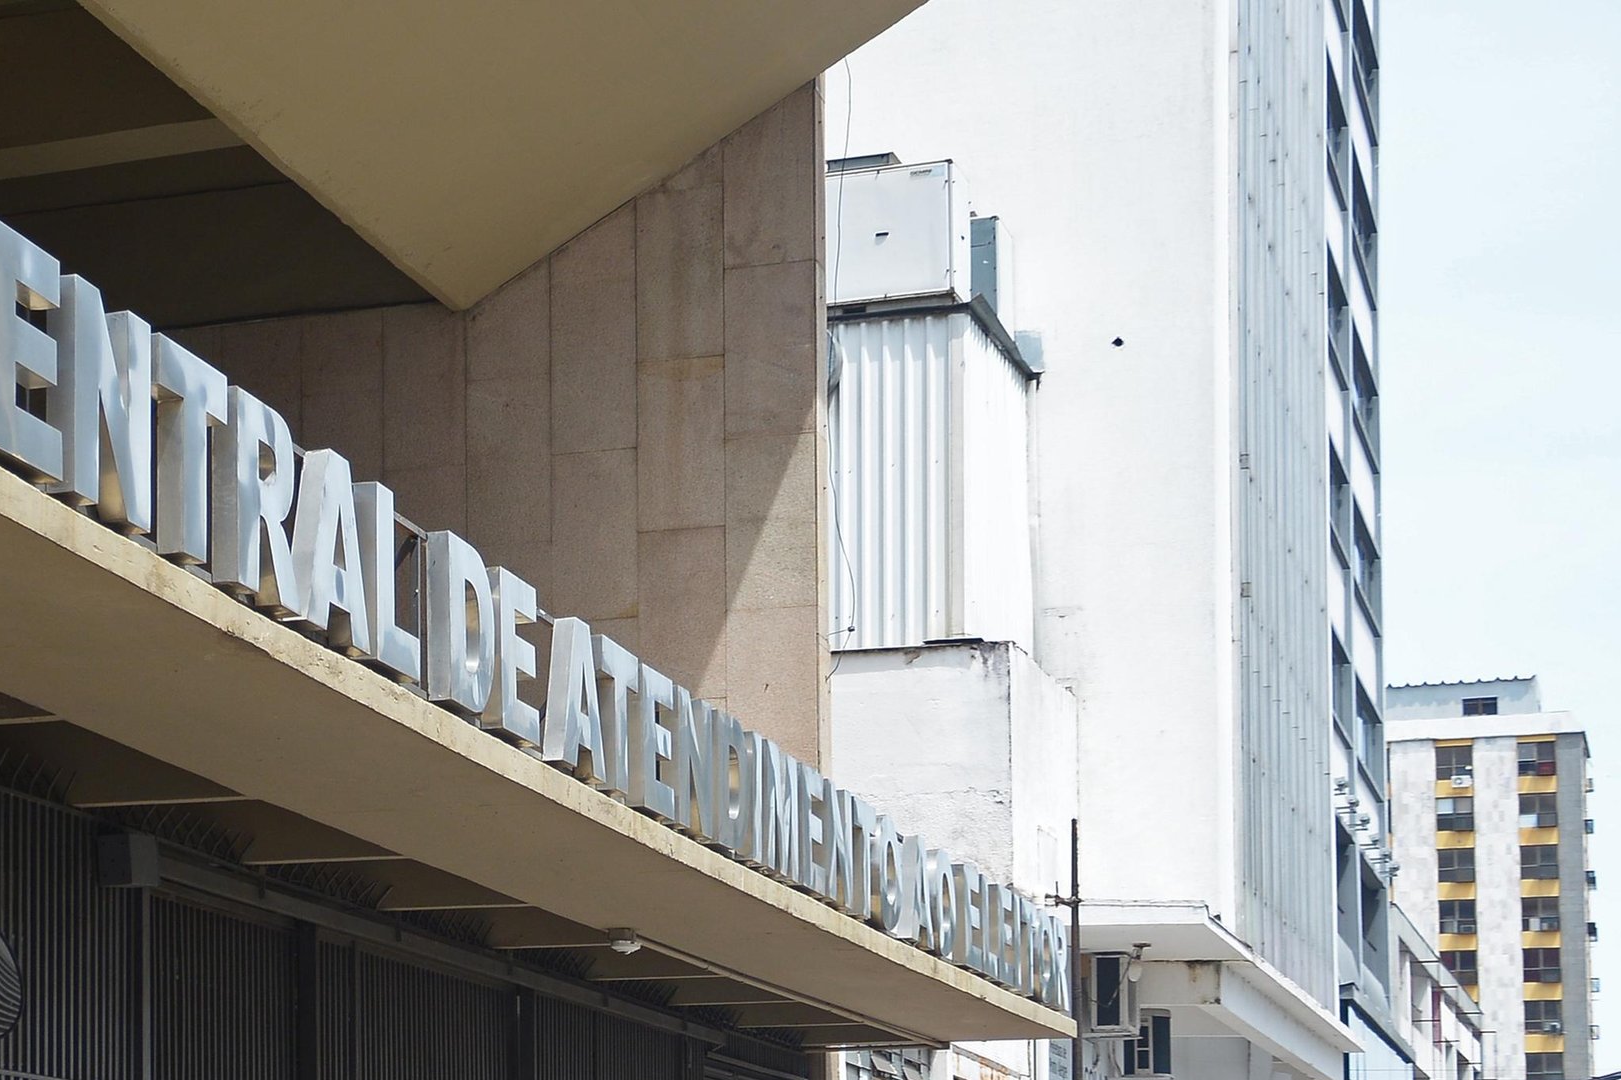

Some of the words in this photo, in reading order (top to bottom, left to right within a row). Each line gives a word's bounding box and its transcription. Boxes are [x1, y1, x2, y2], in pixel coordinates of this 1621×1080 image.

[426, 529, 541, 747] DE
[541, 616, 903, 936] ATENDIMENTO
[896, 834, 957, 959] AO
[950, 863, 1070, 1012] ELEITOR
